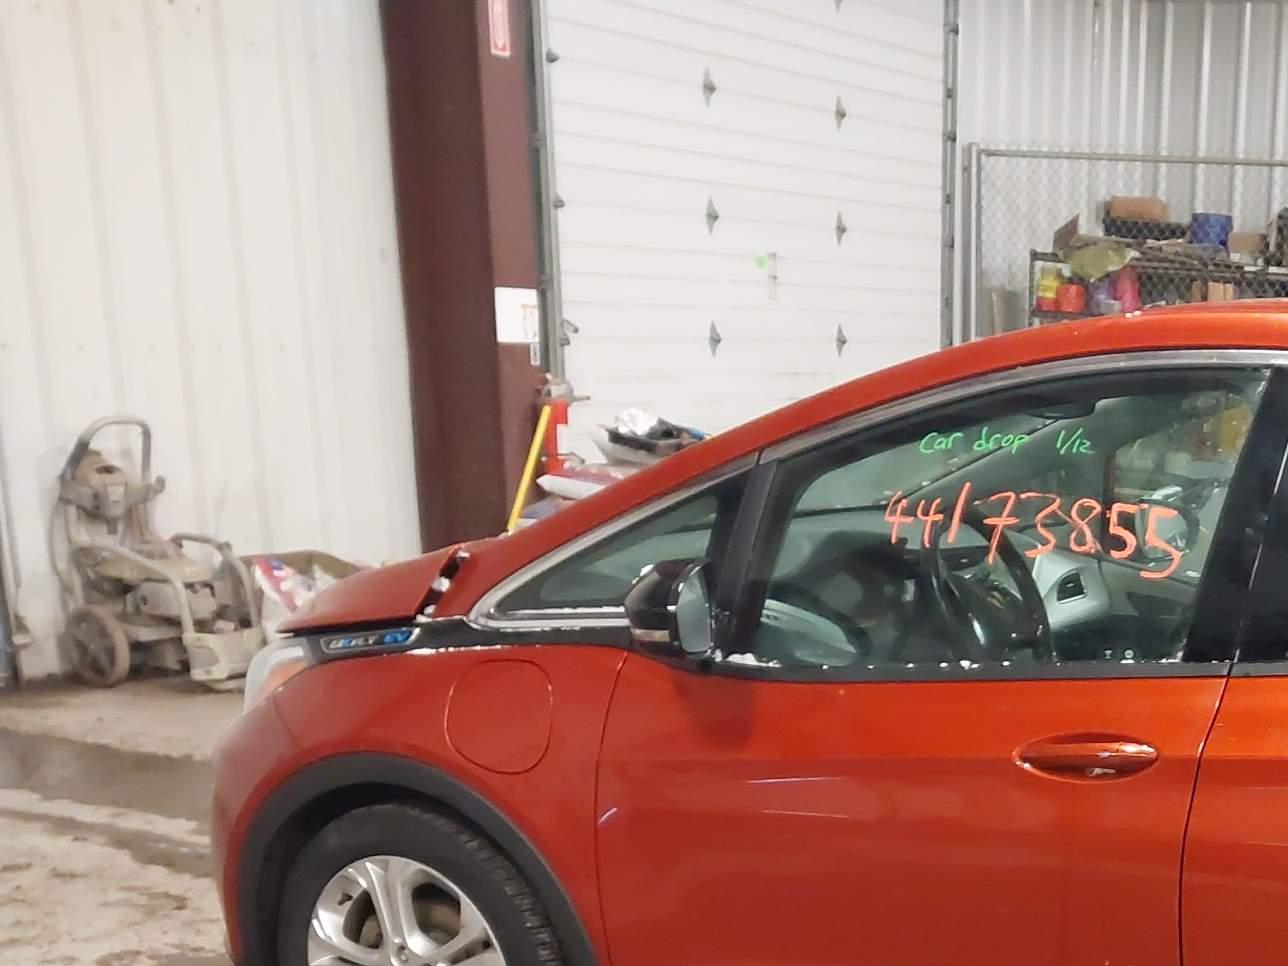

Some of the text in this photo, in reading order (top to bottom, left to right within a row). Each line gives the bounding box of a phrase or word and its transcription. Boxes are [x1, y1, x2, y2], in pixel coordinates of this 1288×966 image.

[972, 426, 1030, 454] drop
[1056, 428, 1097, 454] 1/12
[884, 481, 1185, 579] 44173855
